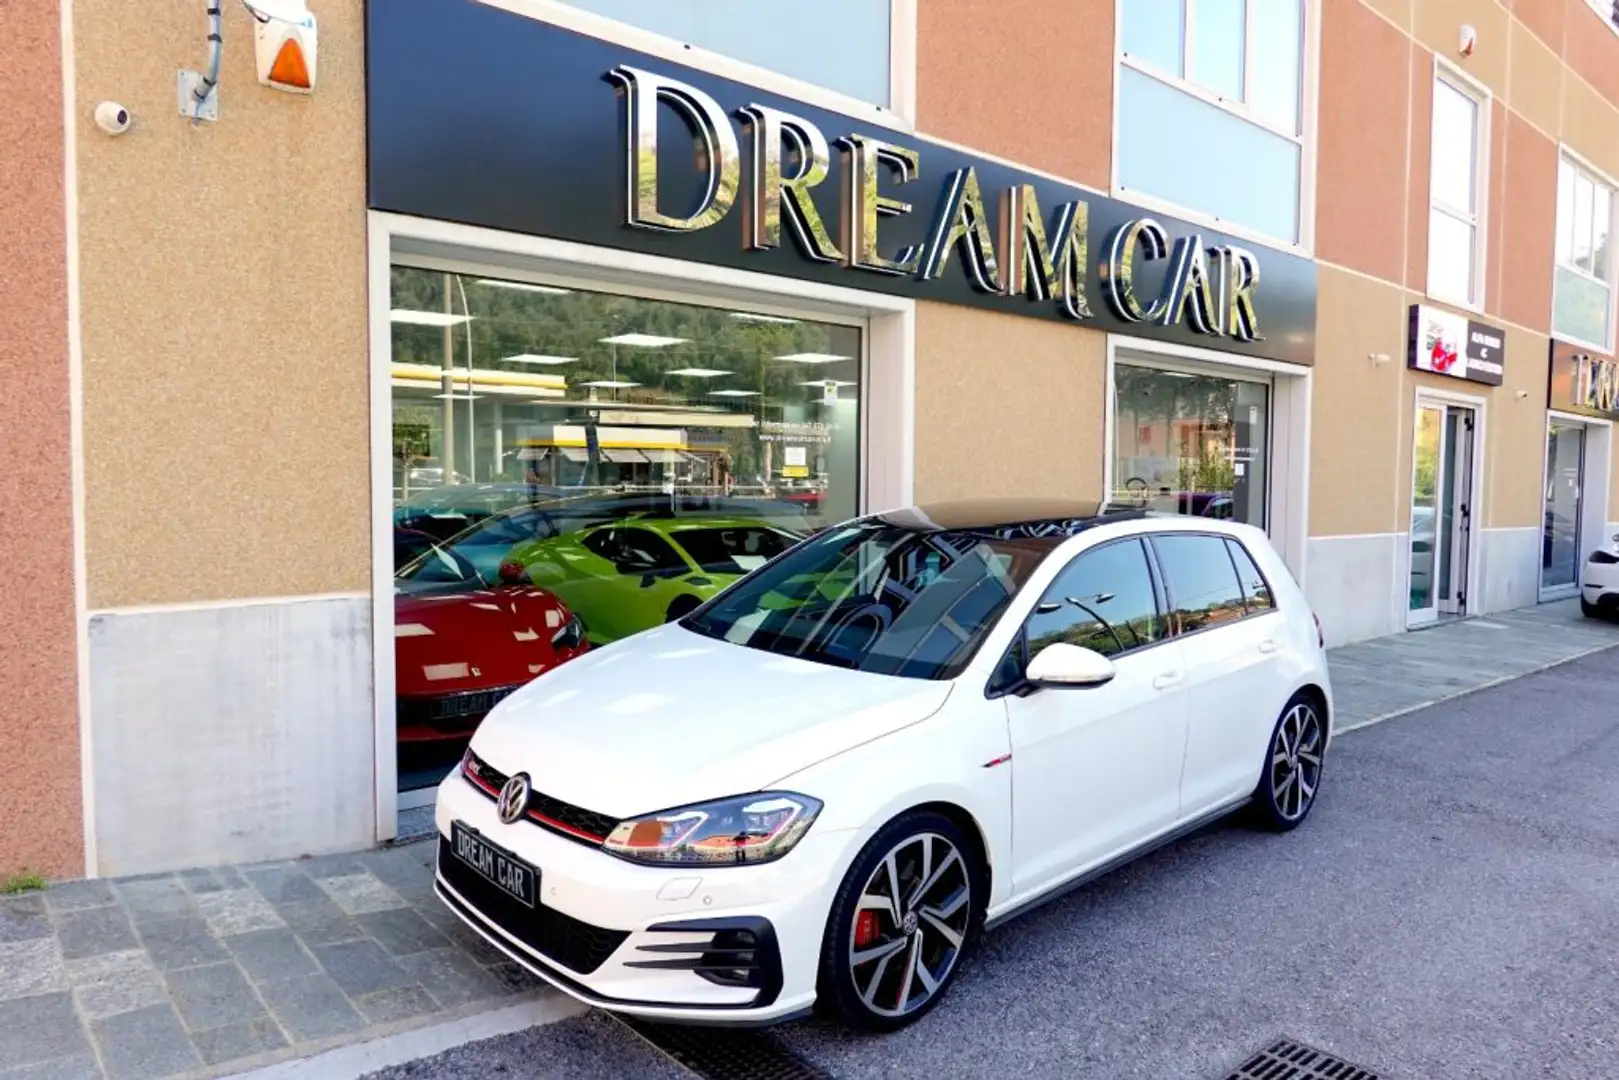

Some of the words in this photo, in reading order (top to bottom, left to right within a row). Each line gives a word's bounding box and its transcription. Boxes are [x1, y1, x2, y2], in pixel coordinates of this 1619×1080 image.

[602, 64, 1093, 320] DREAM
[1099, 217, 1266, 343] CAR
[457, 828, 495, 879] DREAM
[498, 856, 525, 899] CAR
